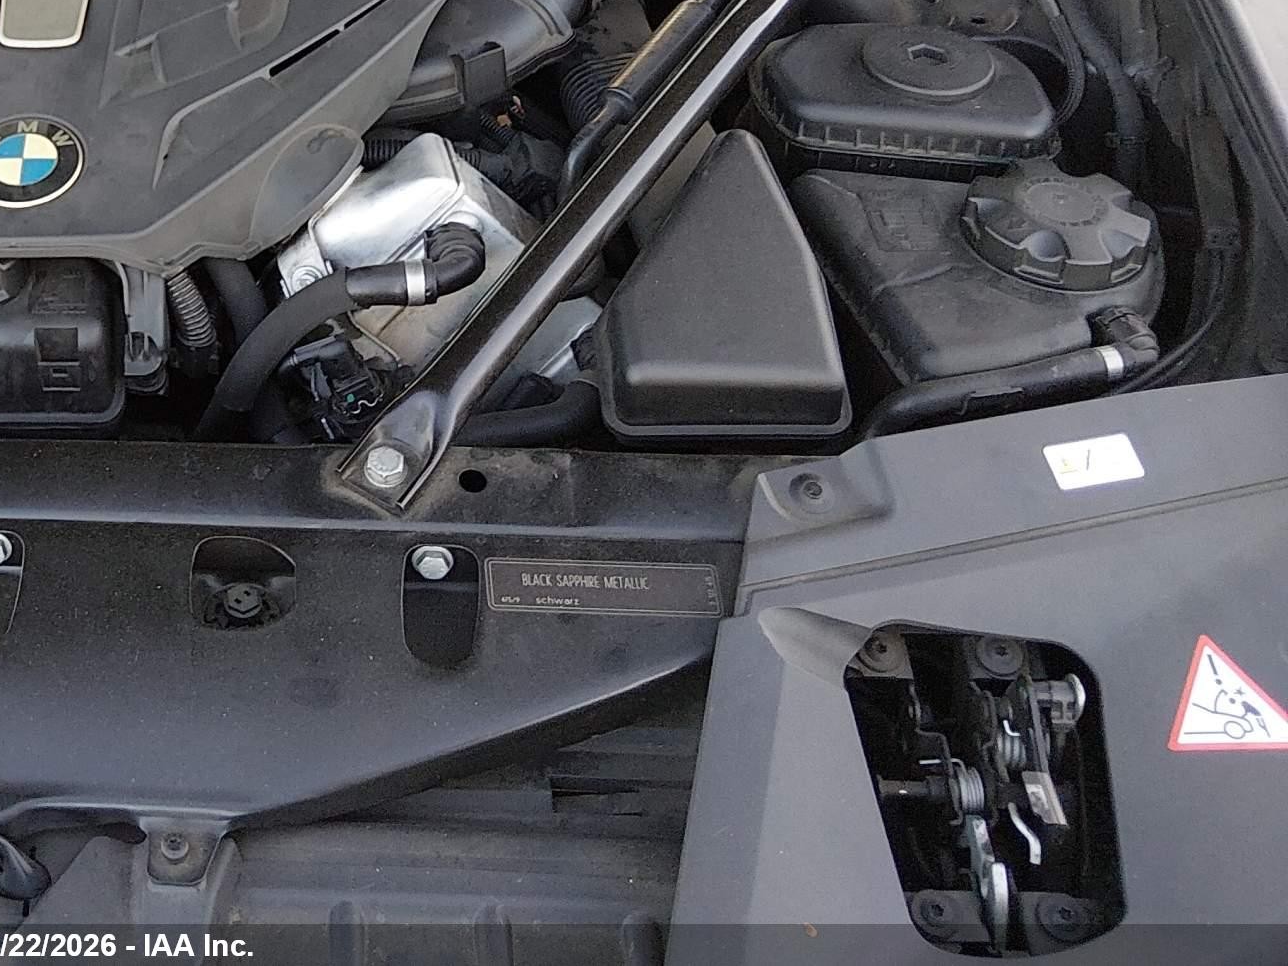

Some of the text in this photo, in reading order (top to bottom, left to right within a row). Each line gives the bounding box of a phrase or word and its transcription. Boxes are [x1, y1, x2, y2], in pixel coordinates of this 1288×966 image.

[521, 573, 650, 591] BLACK SAPPHIRE METALLIC
[535, 596, 580, 606] schwarz
